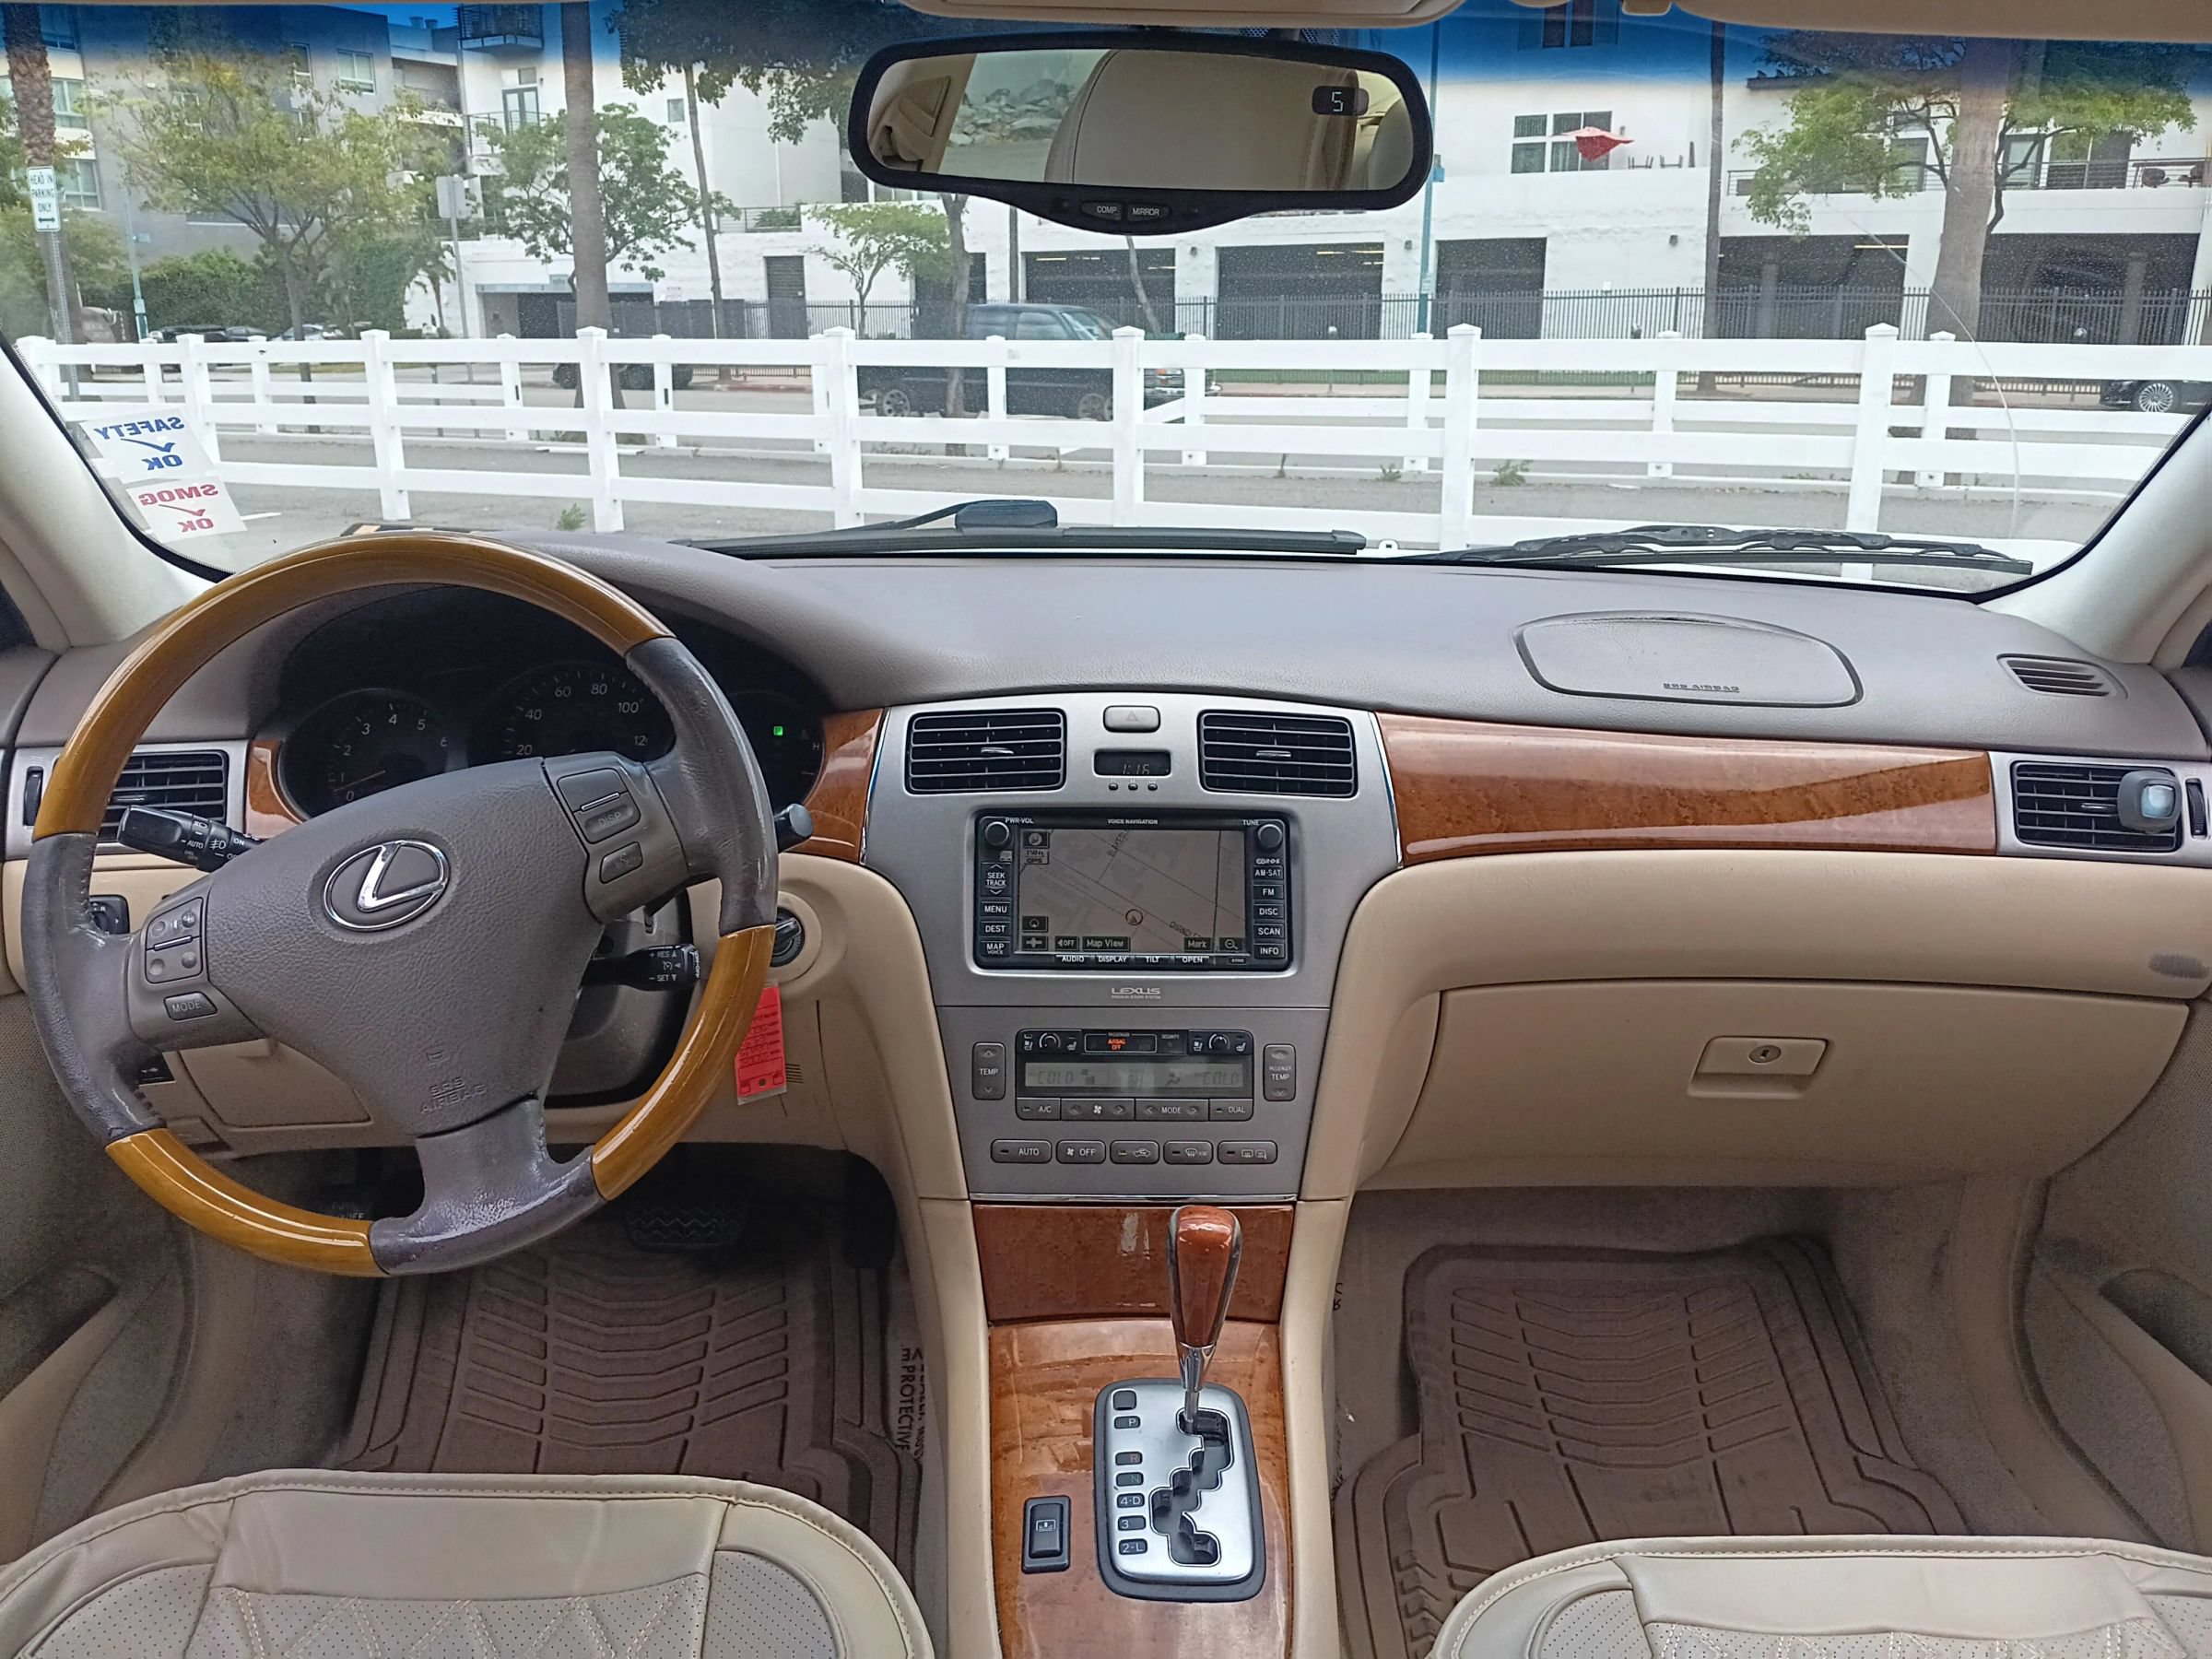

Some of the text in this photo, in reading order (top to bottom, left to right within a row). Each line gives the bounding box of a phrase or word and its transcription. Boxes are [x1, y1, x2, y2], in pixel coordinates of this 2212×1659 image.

[30, 173, 45, 184] HEAD
[31, 188, 54, 198] PARKING
[38, 203, 52, 212] ONLY
[1097, 206, 1117, 214] COMP
[1132, 207, 1159, 216] MIRROR
[554, 686, 571, 698] 60
[591, 683, 607, 695] 80
[1692, 684, 1740, 692] AIRBAG
[618, 701, 640, 713] 100
[388, 713, 397, 725] 4
[524, 709, 543, 720] 40
[361, 723, 371, 735] 3
[417, 719, 426, 730] 5
[633, 735, 648, 747] 12
[343, 745, 352, 756] 2
[516, 744, 533, 756] 20
[812, 742, 820, 750] H
[346, 791, 355, 801] 0
[598, 811, 621, 827] DISP
[186, 840, 204, 849] AUTO
[984, 905, 1007, 913] MENU
[1258, 927, 1281, 935] SCAN
[1087, 938, 1124, 947] Map View
[1187, 939, 1206, 948] Mark
[1260, 947, 1279, 955] INFO
[171, 1000, 202, 1013] MODE
[1079, 1147, 1096, 1156] OFF
[894, 1364, 916, 1452] PROTECTIVE
[1128, 1418, 1136, 1427] P
[1130, 1454, 1138, 1463] R
[1131, 1475, 1139, 1484] N
[1121, 1520, 1129, 1529] 3
